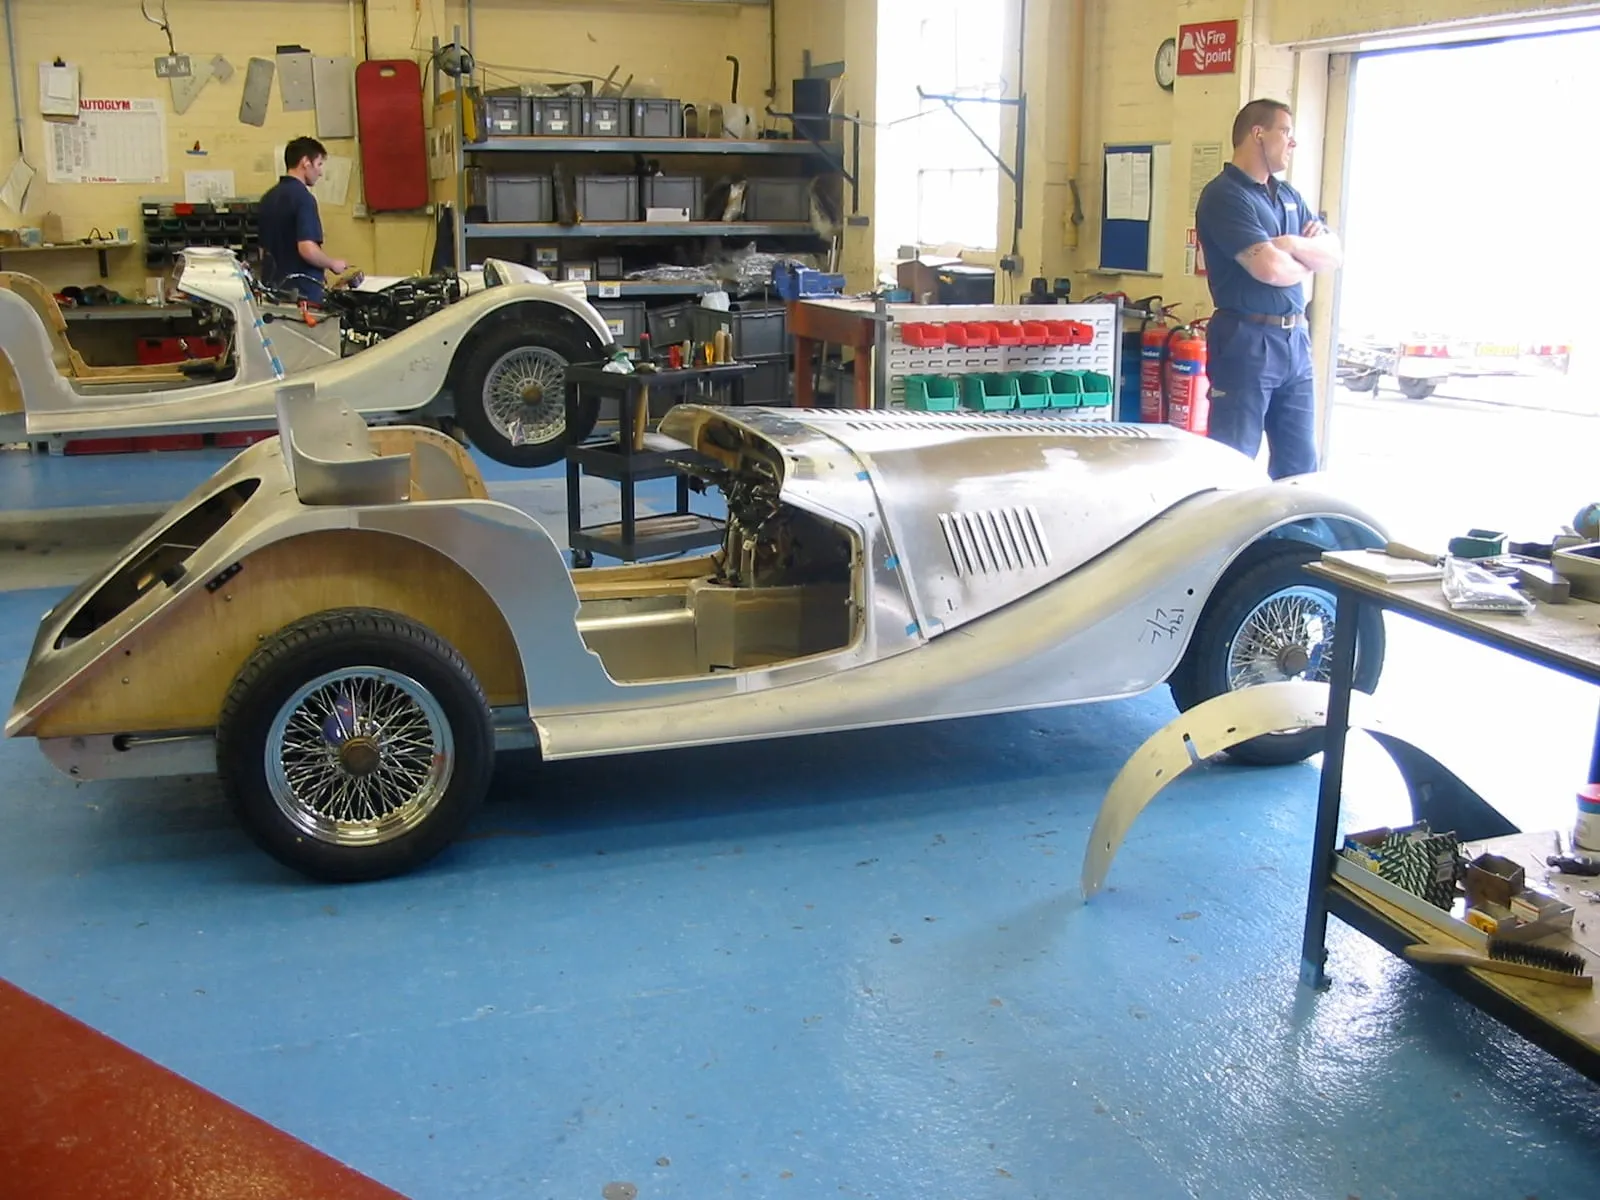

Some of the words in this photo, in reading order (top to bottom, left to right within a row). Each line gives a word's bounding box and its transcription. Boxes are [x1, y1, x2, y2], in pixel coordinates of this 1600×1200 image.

[1207, 30, 1226, 45] Fire
[1205, 48, 1231, 67] point
[80, 99, 130, 110] AUTOGLYM
